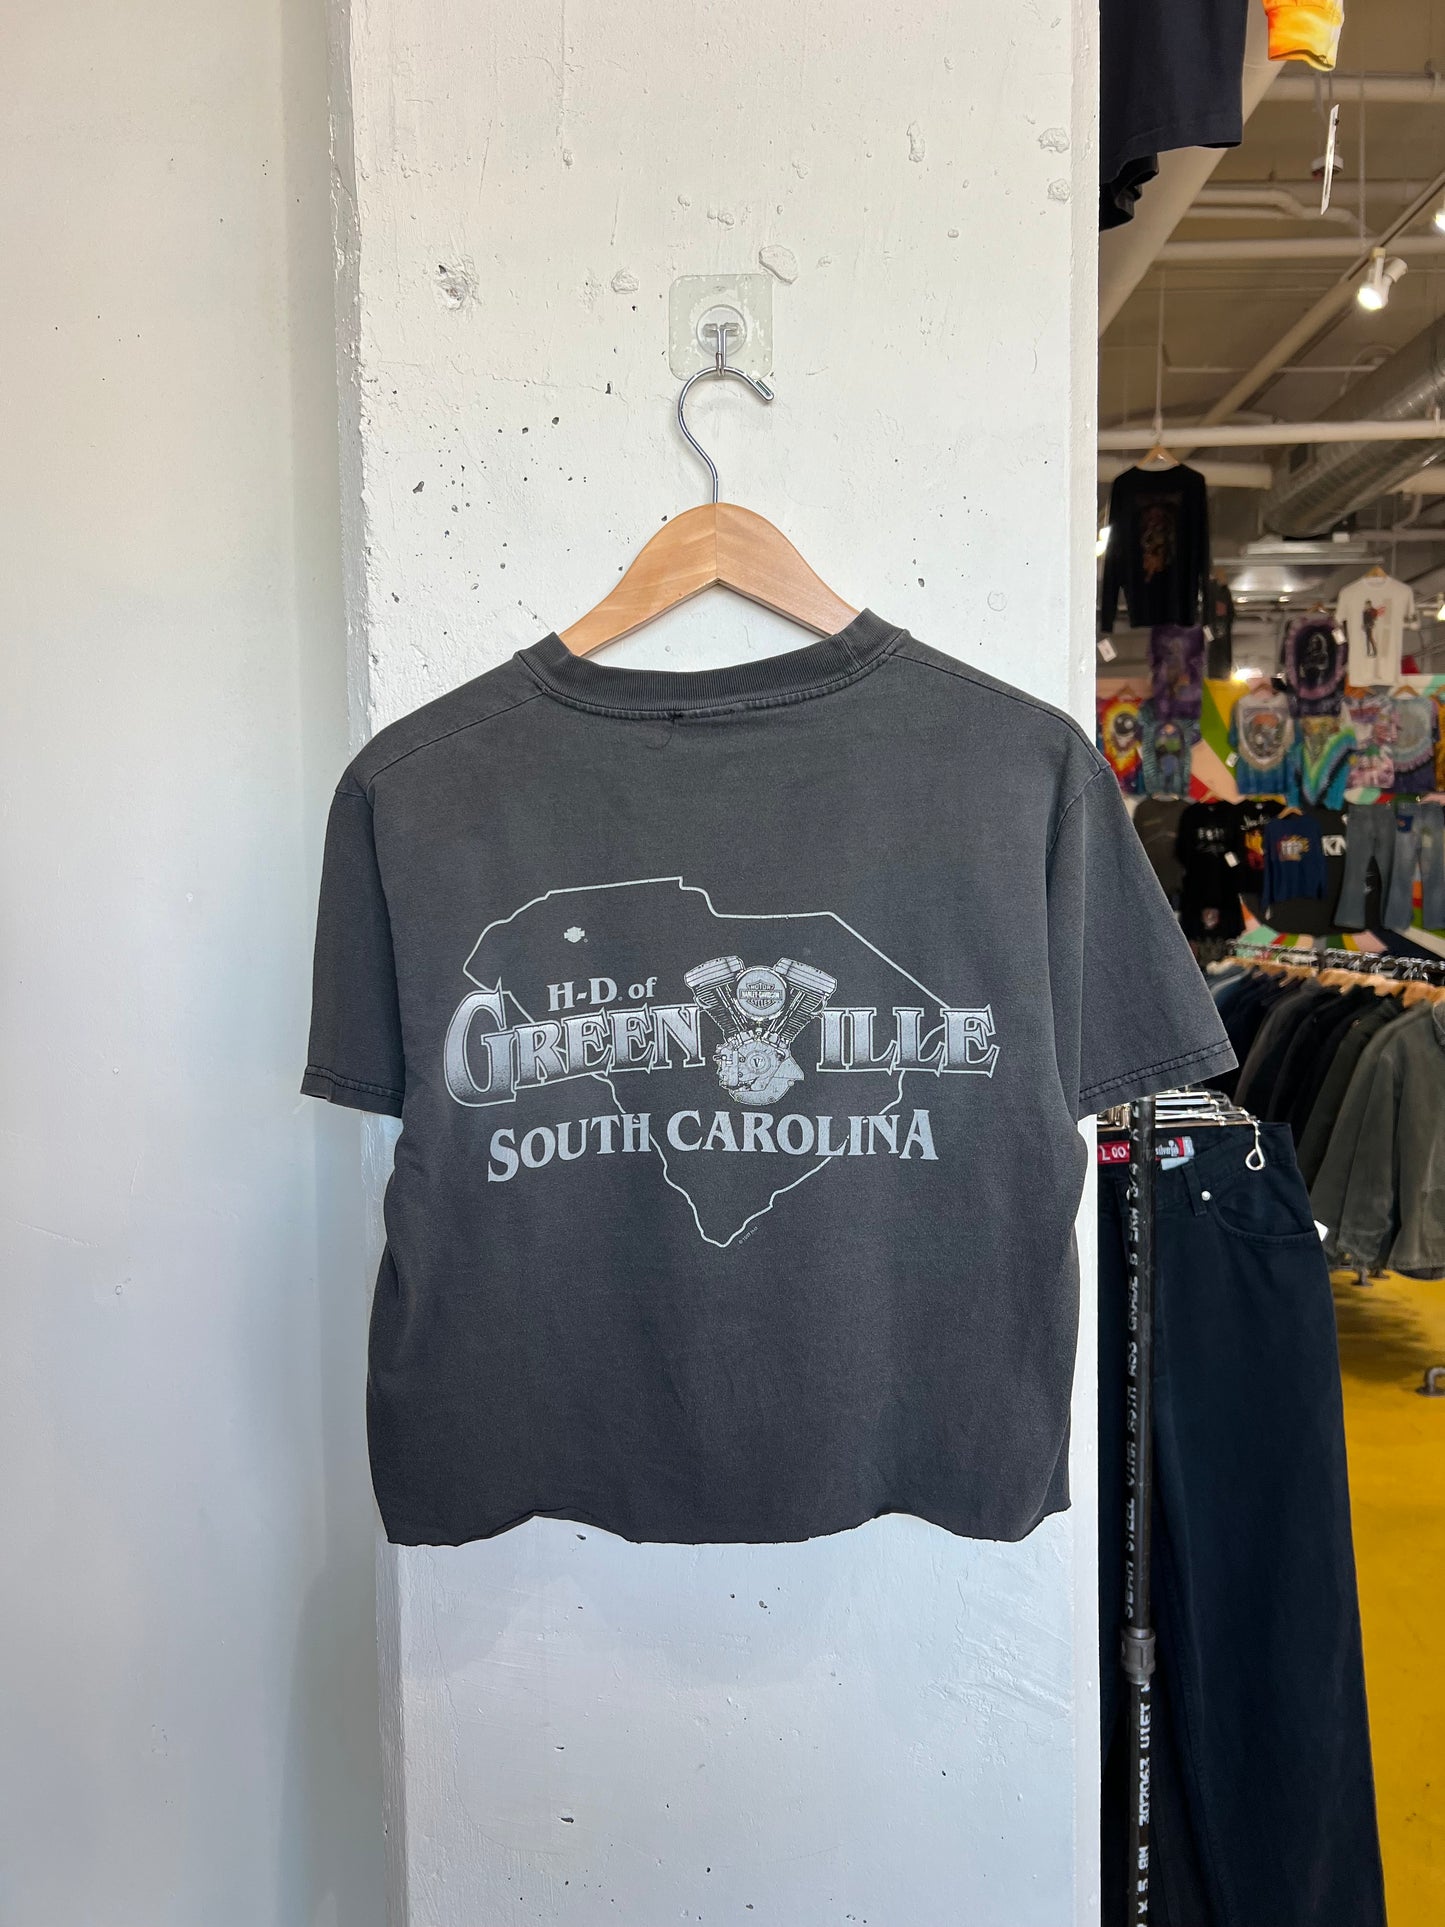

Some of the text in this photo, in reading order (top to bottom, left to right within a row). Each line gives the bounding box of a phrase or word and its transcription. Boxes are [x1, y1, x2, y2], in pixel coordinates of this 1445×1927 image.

[628, 976, 658, 999] of
[487, 1109, 939, 1182] SOUTH CAROLINA
